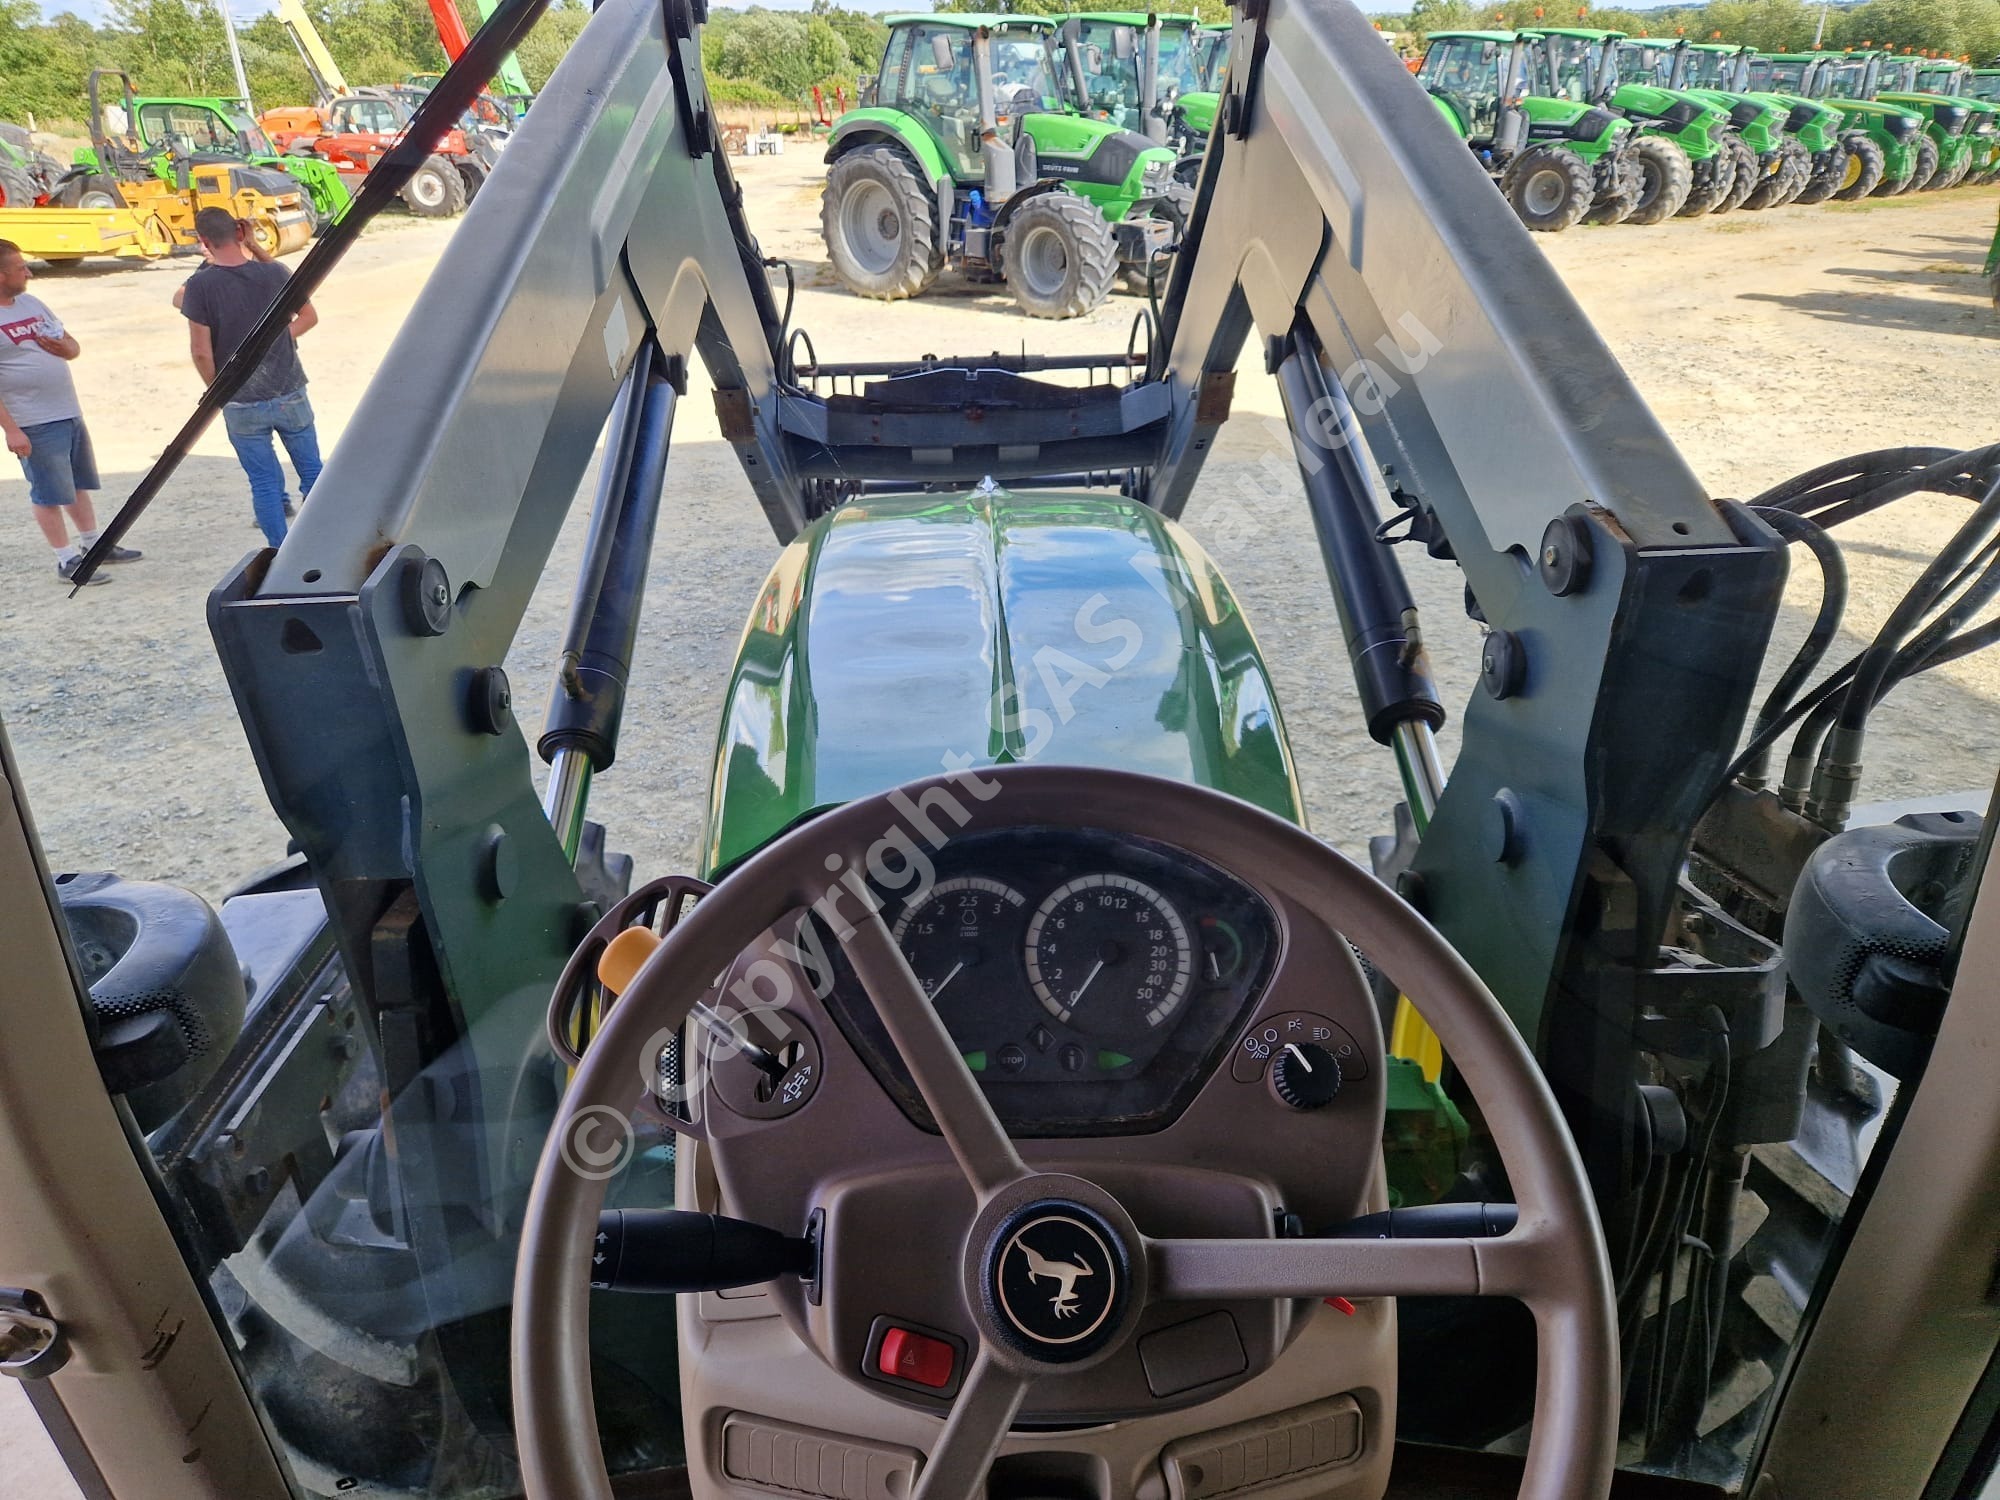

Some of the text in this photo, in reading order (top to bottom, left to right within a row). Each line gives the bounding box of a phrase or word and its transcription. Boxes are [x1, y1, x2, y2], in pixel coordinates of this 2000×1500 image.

[959, 896, 978, 907] 2.5
[1074, 901, 1084, 912] 8
[1098, 896, 1113, 906] 10
[1115, 898, 1128, 909] 12
[937, 905, 945, 915] 2
[992, 904, 1001, 914] 3
[1135, 912, 1149, 923] 15
[918, 924, 934, 935] 1.5
[1056, 919, 1065, 929] 6
[1149, 930, 1163, 940] 18
[1047, 943, 1056, 954] 4
[1151, 946, 1167, 957] 20
[1150, 960, 1167, 971] 30
[1054, 969, 1063, 980] 2
[1145, 975, 1162, 986] 40
[1136, 988, 1153, 999] 50
[1002, 1056, 1023, 1065] STOP
